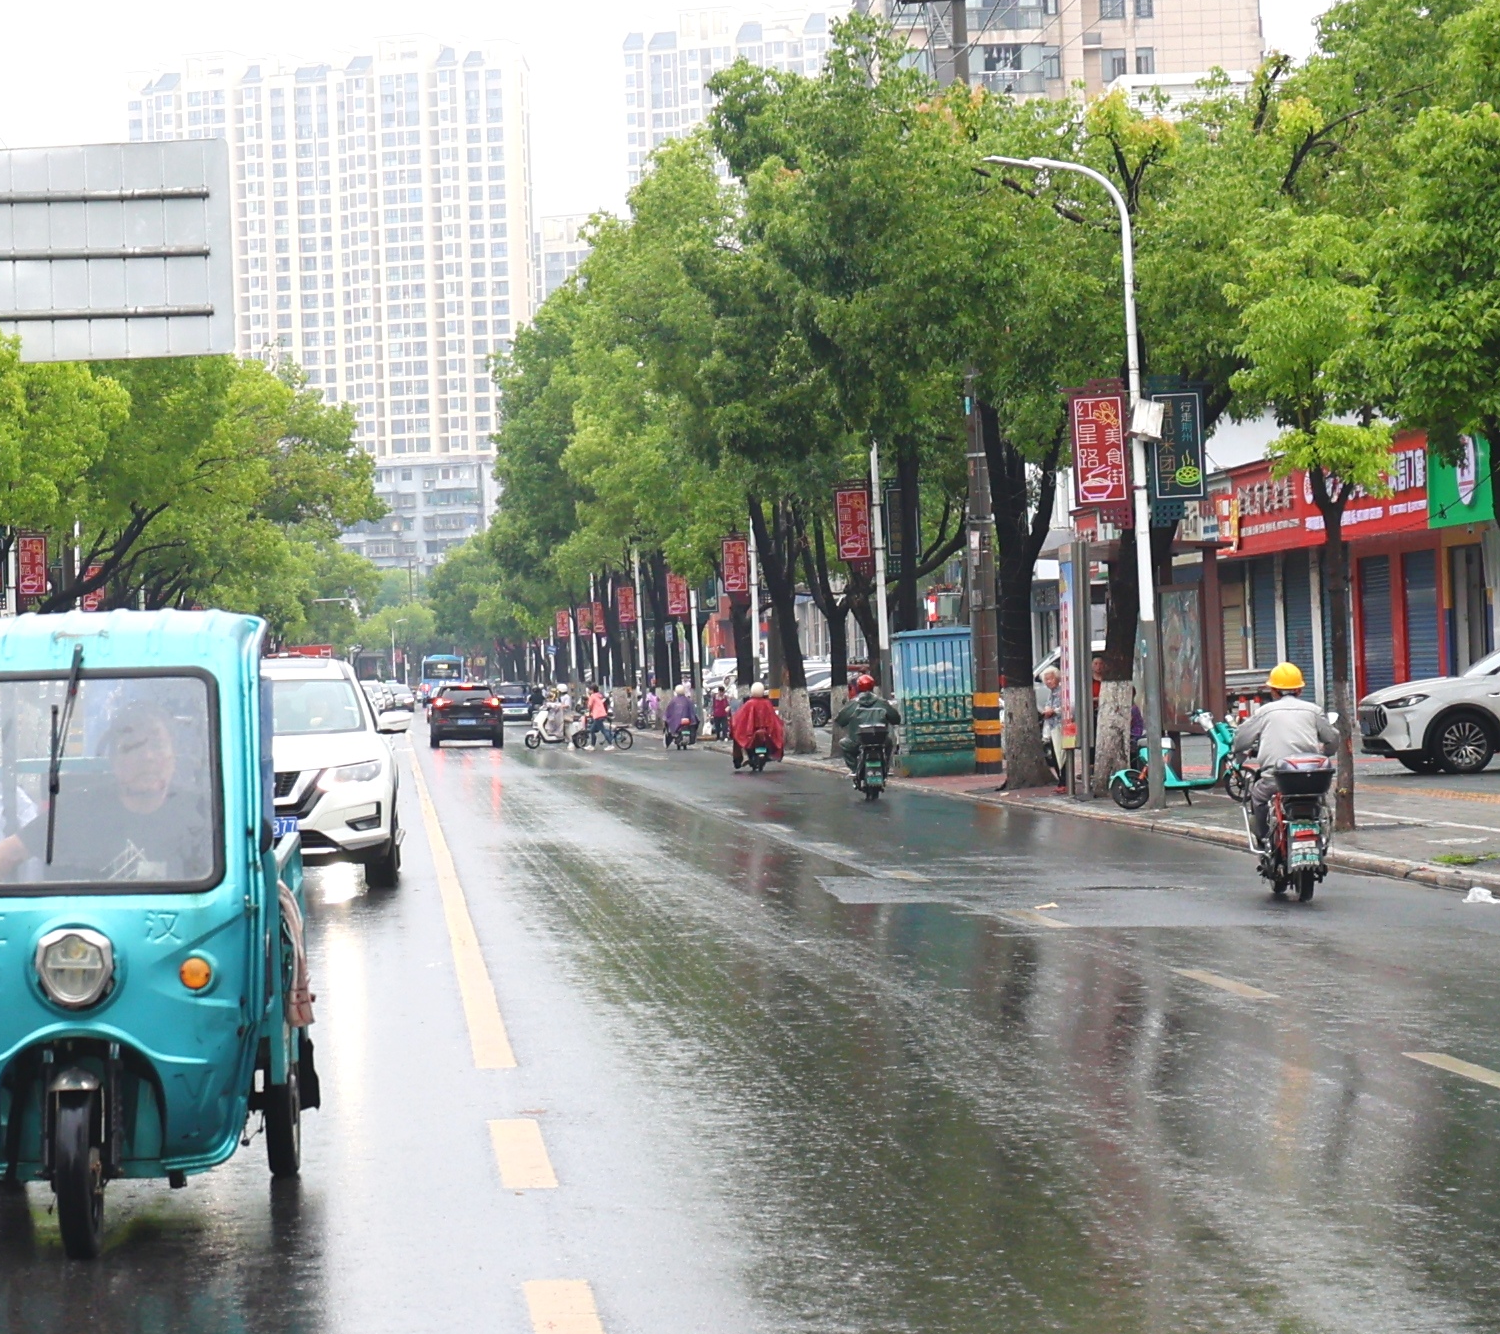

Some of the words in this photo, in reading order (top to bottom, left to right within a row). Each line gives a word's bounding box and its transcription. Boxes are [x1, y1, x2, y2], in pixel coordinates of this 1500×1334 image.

[1076, 400, 1099, 468] 红星路
[1180, 401, 1193, 442] 行走荆州
[1104, 427, 1123, 486] 美食街
[146, 911, 183, 944] 汉
